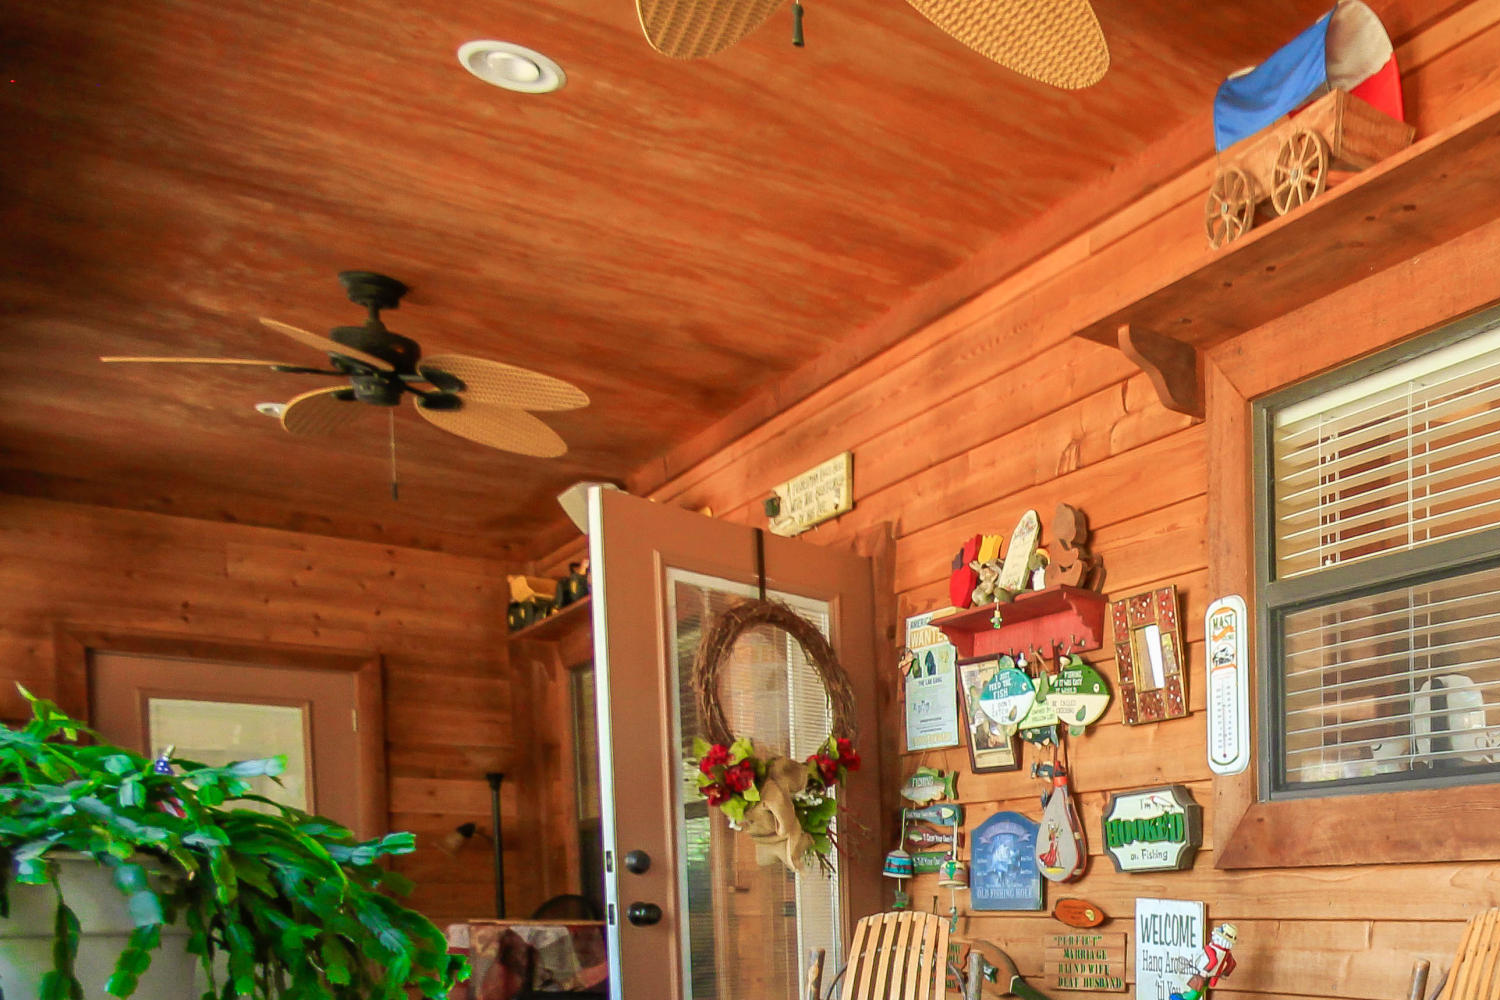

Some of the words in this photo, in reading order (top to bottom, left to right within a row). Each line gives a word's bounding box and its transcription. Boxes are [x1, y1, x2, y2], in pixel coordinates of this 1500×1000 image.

[1213, 614, 1233, 629] MAST
[910, 628, 946, 649] WANTE
[993, 688, 1008, 699] FISH
[1141, 848, 1168, 861] Fishing
[1140, 912, 1197, 948] WELCOME
[1063, 948, 1107, 960] MARRIAGE
[1058, 963, 1086, 974] BLIND
[1088, 964, 1110, 975] WIFE
[1142, 949, 1163, 978] Hang
[1058, 977, 1079, 988] DEAF
[1084, 976, 1122, 989] HUSBAND
